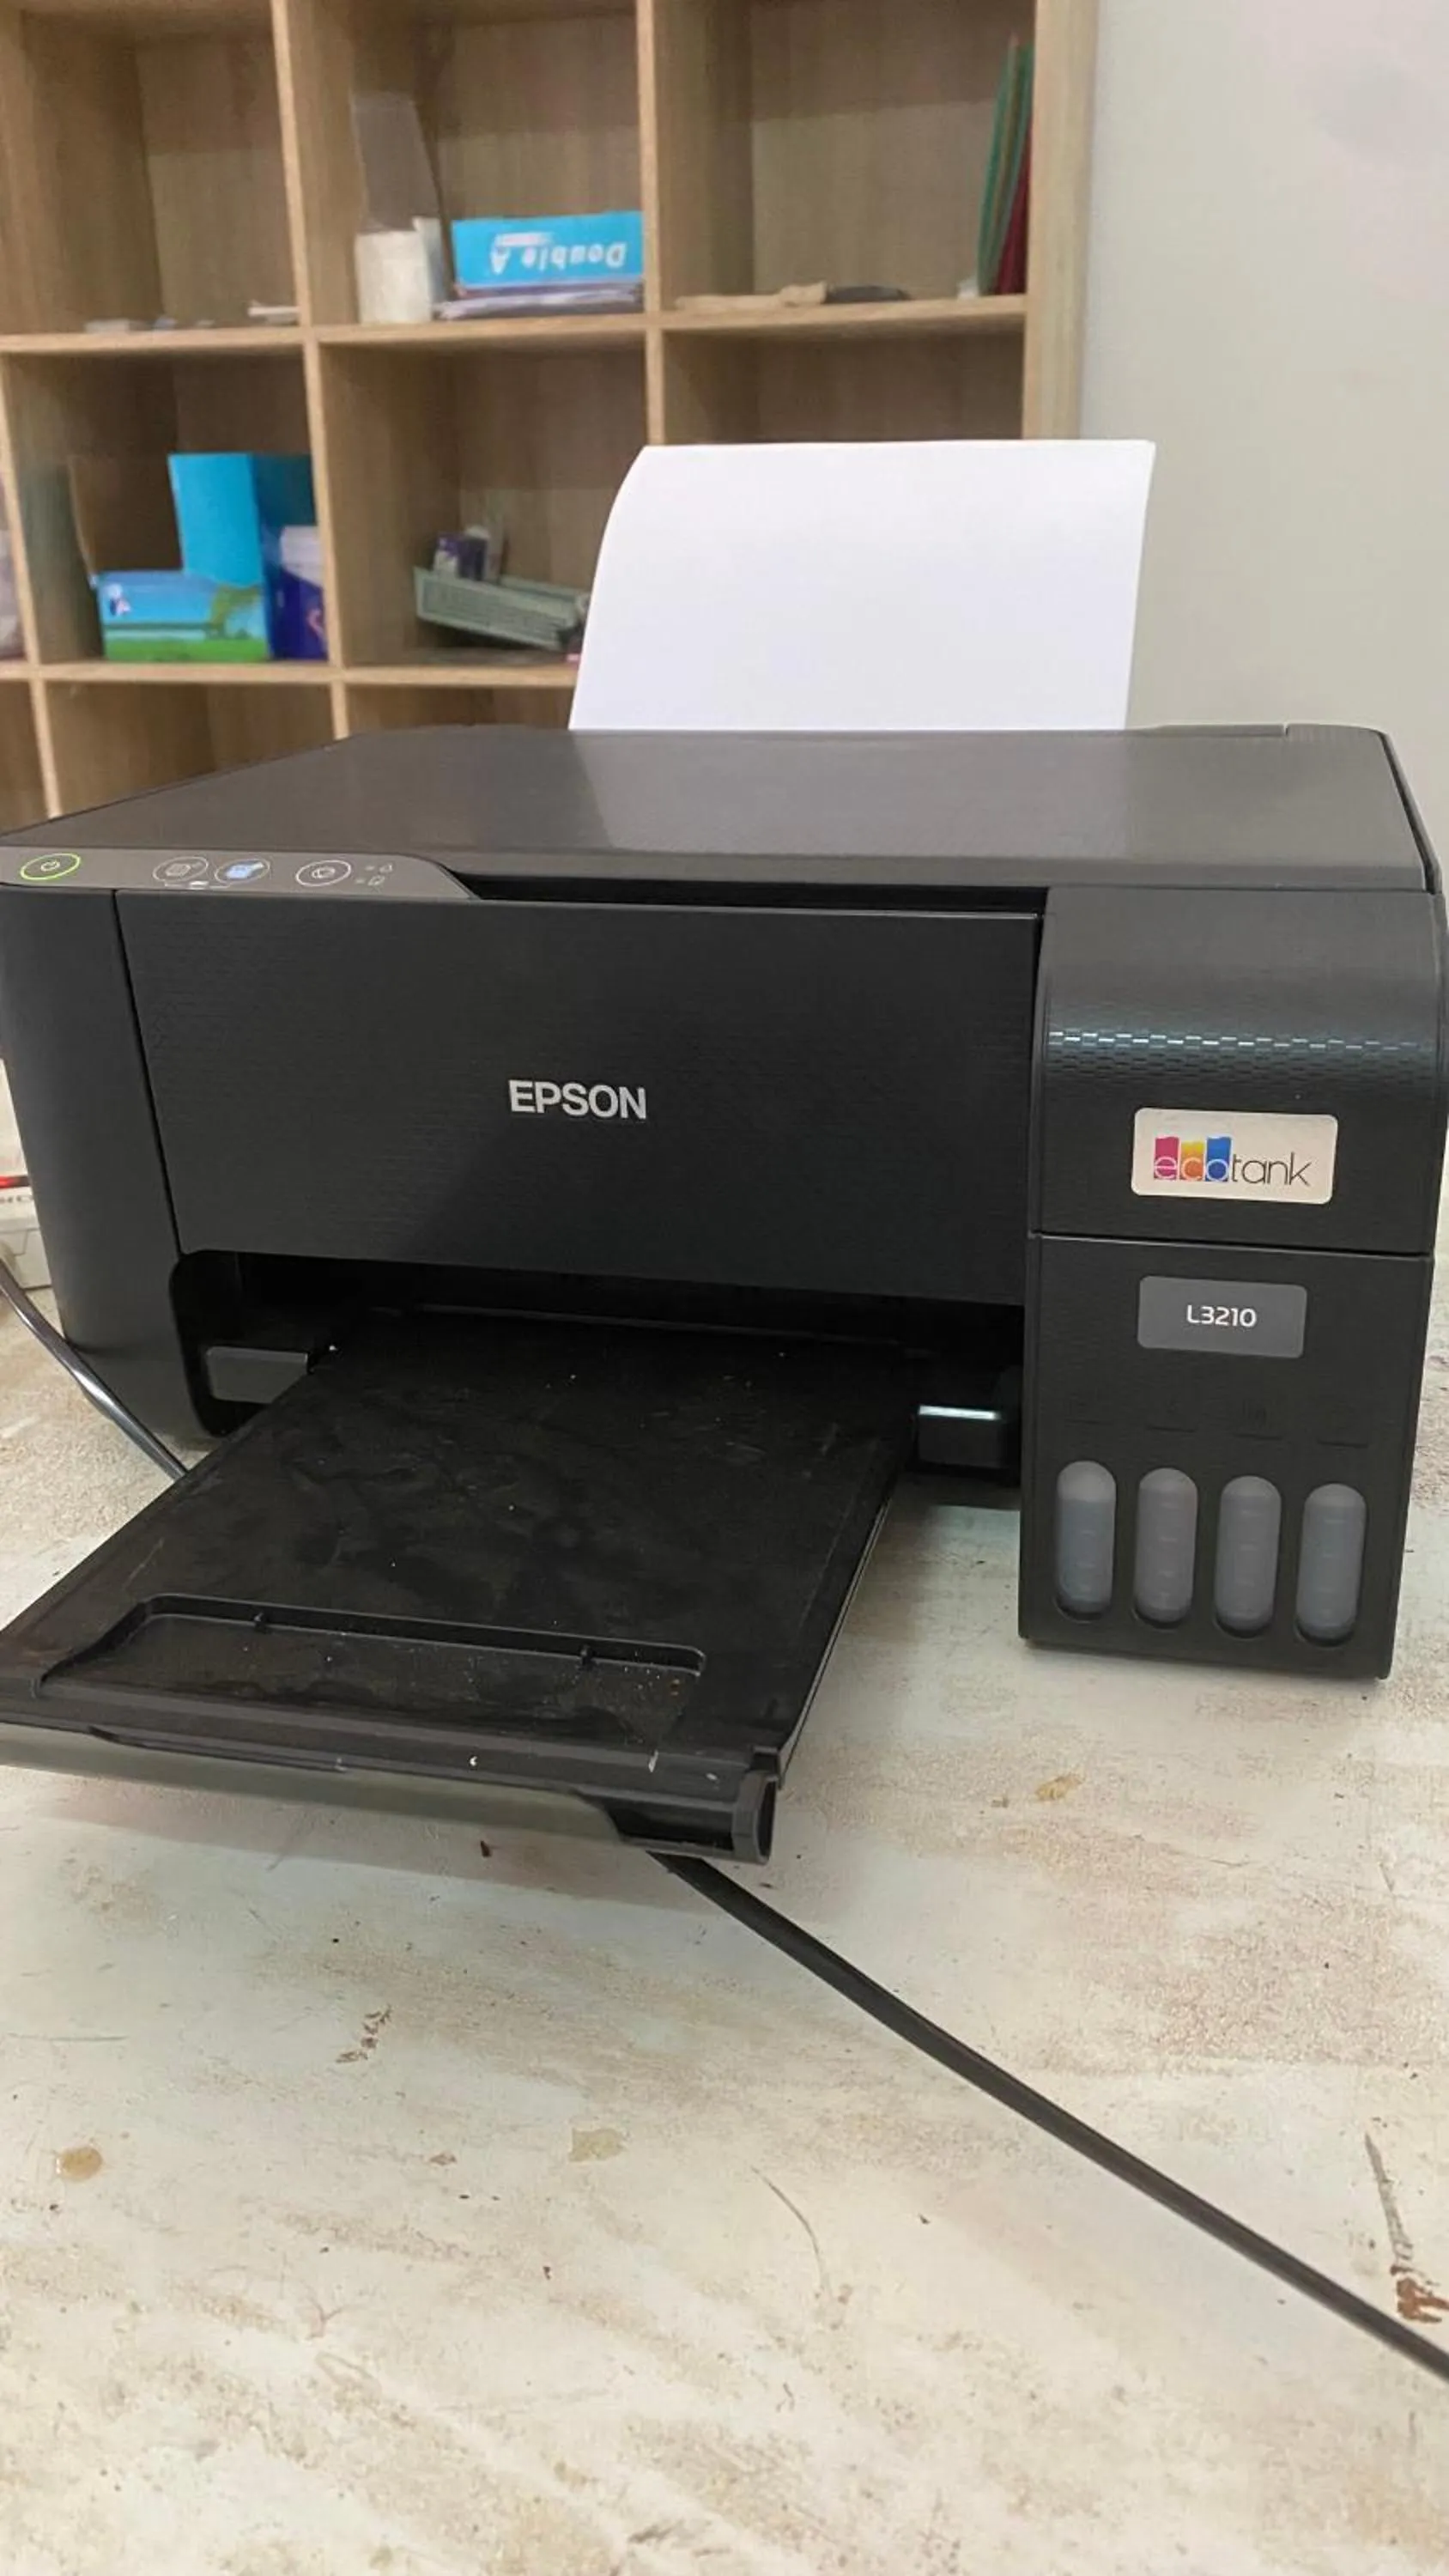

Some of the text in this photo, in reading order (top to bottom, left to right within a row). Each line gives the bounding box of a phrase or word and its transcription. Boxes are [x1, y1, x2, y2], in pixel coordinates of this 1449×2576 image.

[521, 242, 627, 271] Double
[508, 1078, 646, 1120] EPSON
[1154, 1149, 1313, 1187] ecotank
[1186, 1304, 1257, 1327] L3210
